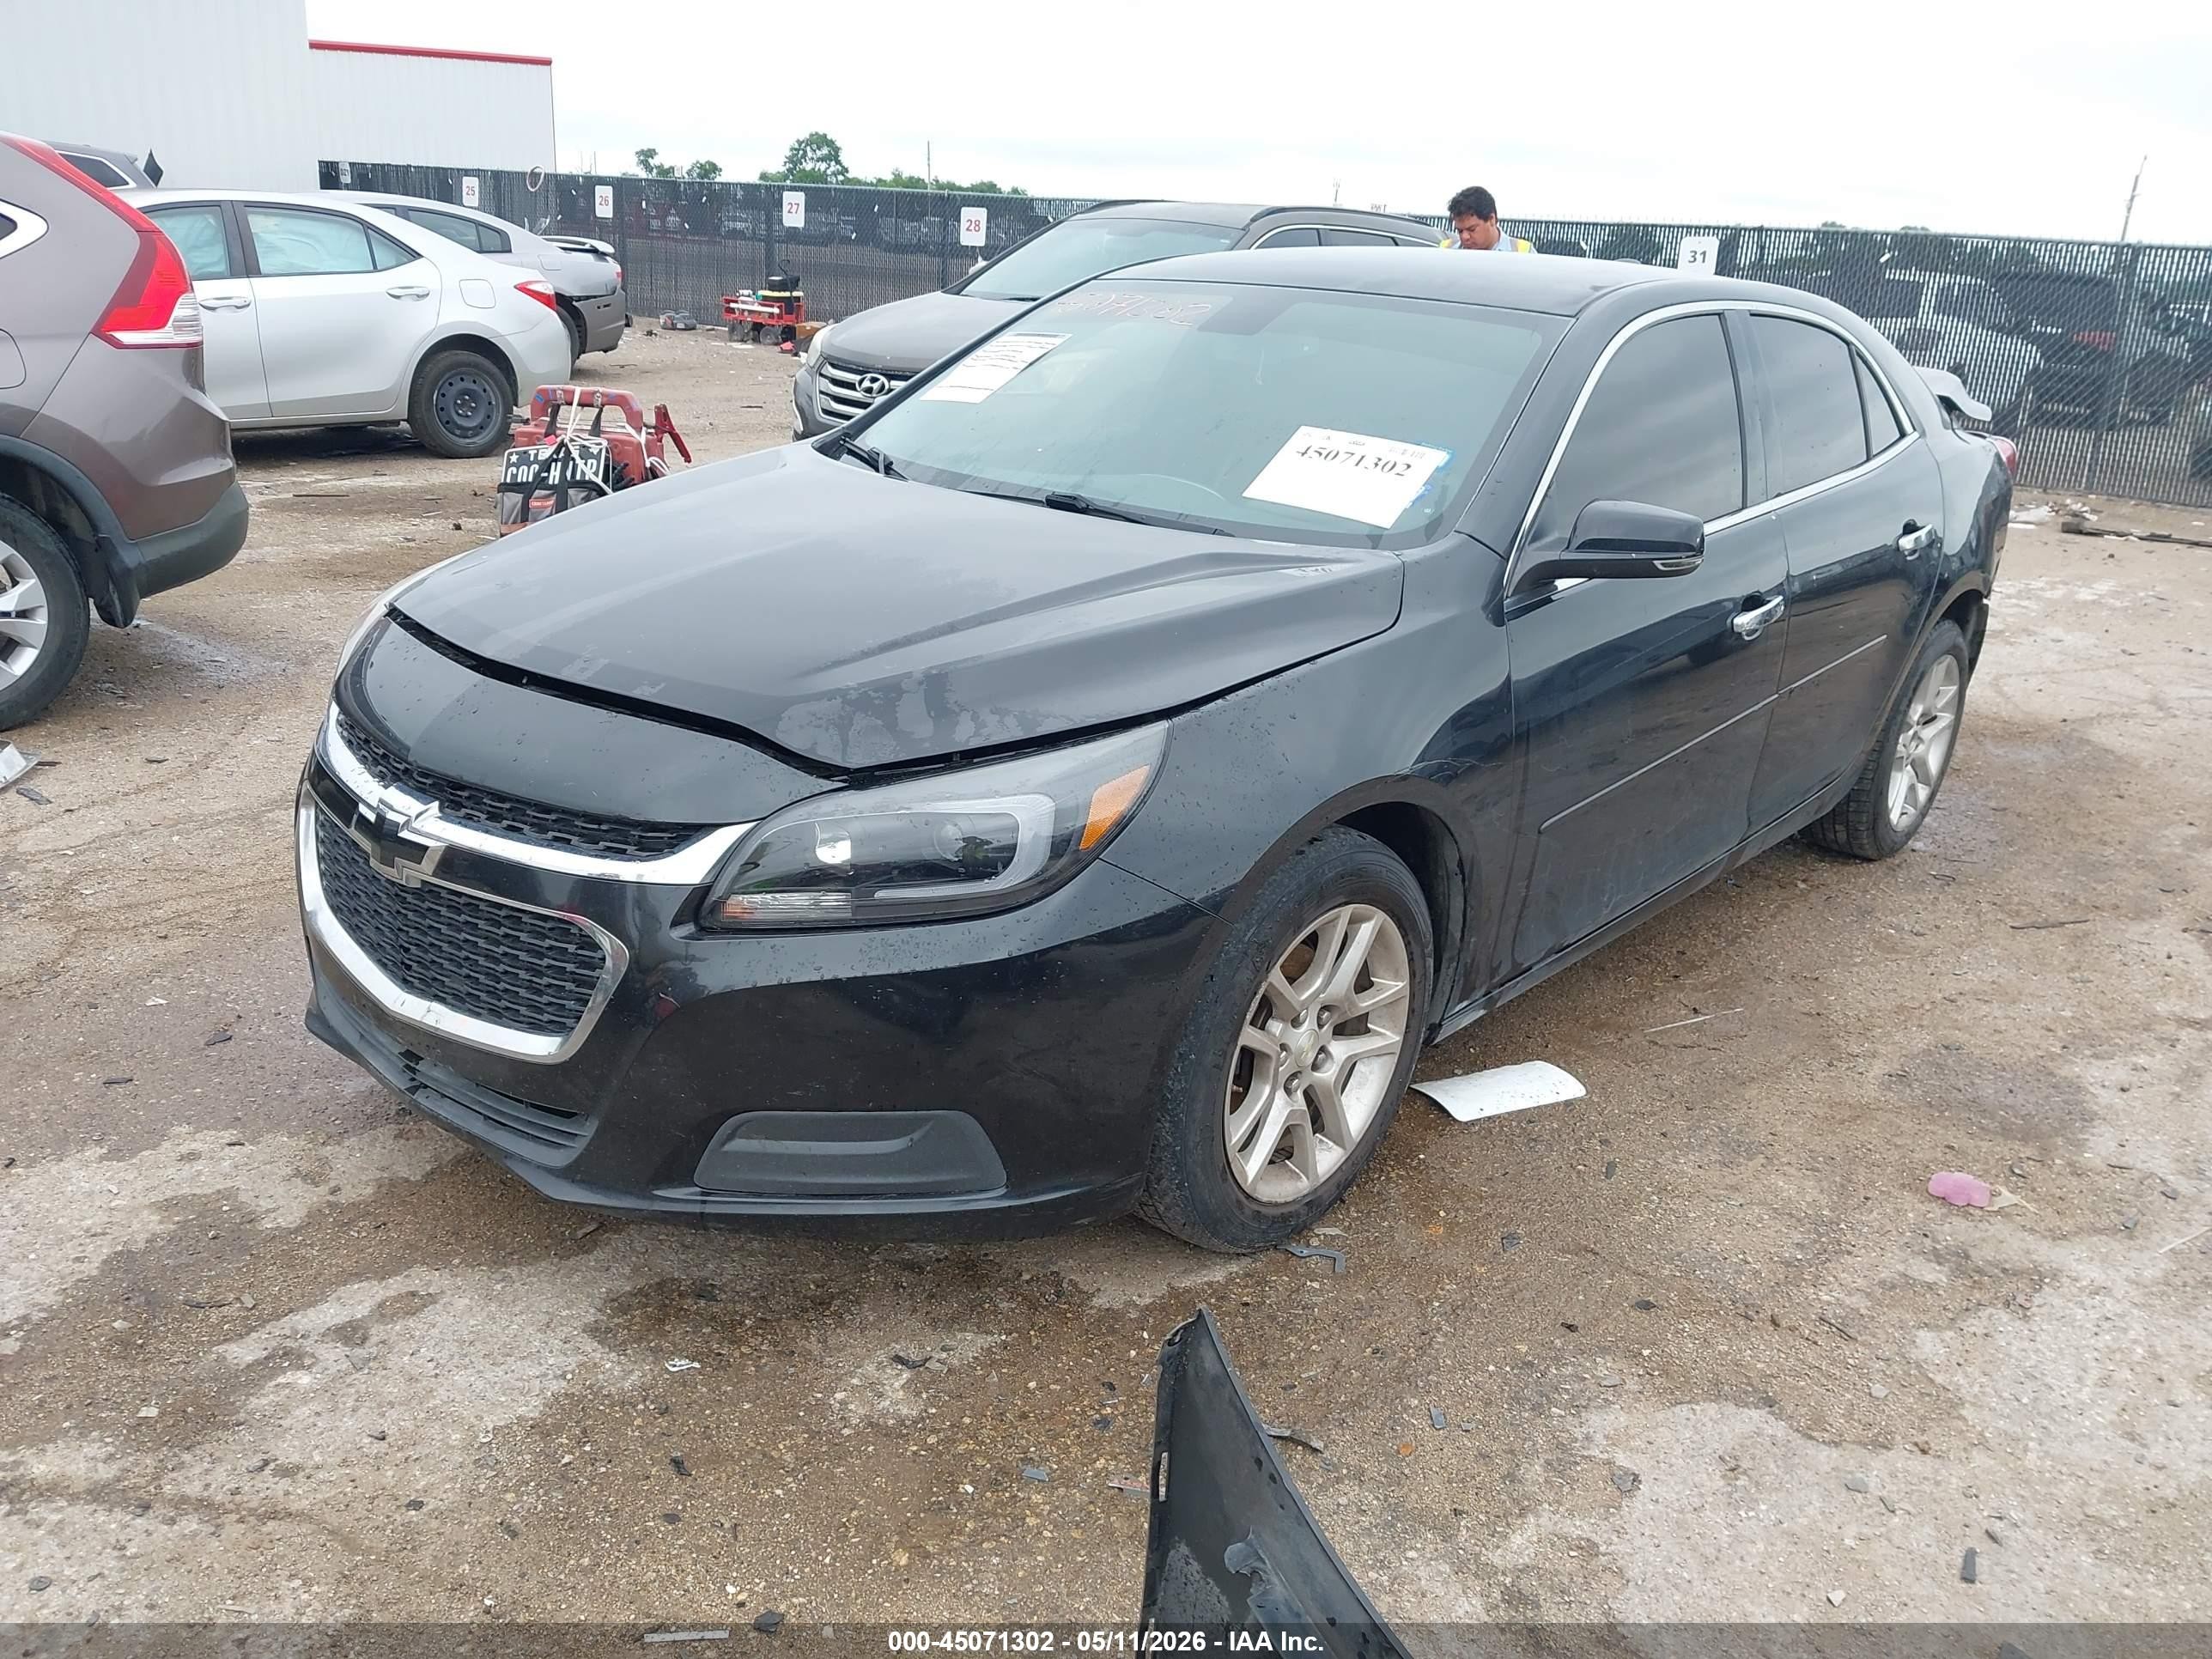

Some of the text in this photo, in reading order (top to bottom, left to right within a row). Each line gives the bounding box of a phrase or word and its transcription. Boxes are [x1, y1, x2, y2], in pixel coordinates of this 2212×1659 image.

[465, 185, 476, 197] 25
[599, 195, 610, 207] 26
[787, 202, 800, 215] 27
[965, 218, 981, 233] 28
[1687, 250, 1707, 264] 31
[1296, 445, 1413, 477] 45071302
